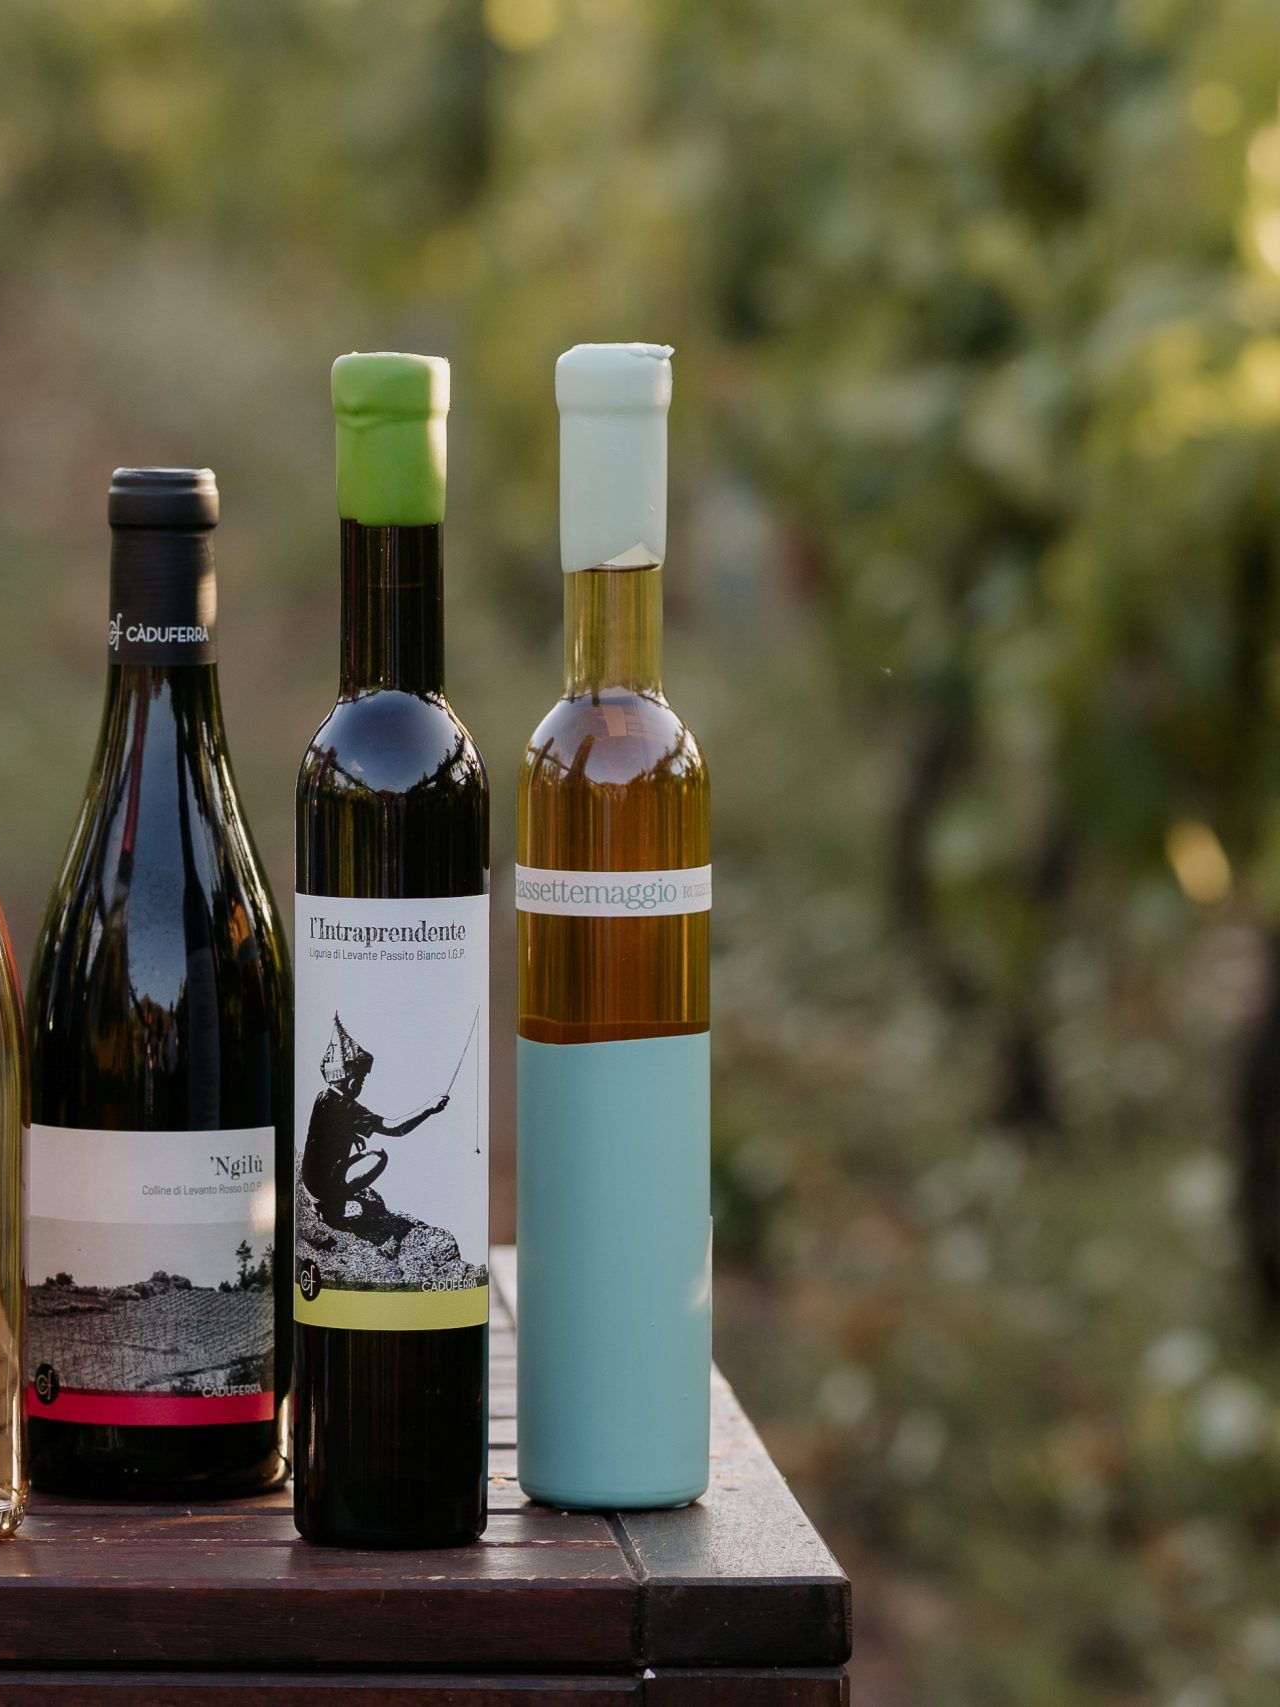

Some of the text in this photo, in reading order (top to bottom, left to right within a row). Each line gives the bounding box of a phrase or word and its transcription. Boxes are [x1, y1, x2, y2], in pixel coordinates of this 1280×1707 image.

[125, 622, 209, 643] CÀDUFERRÀ
[309, 916, 467, 948] l'Intraprendente
[309, 946, 332, 961] Liguria
[333, 948, 341, 960] di
[342, 949, 378, 961] Levante
[380, 950, 415, 961] Passito
[417, 949, 446, 961] Bianco
[141, 1184, 172, 1196] Colline
[174, 1184, 182, 1196] di
[184, 1184, 218, 1196] Levanto
[219, 1183, 242, 1194] Rosso
